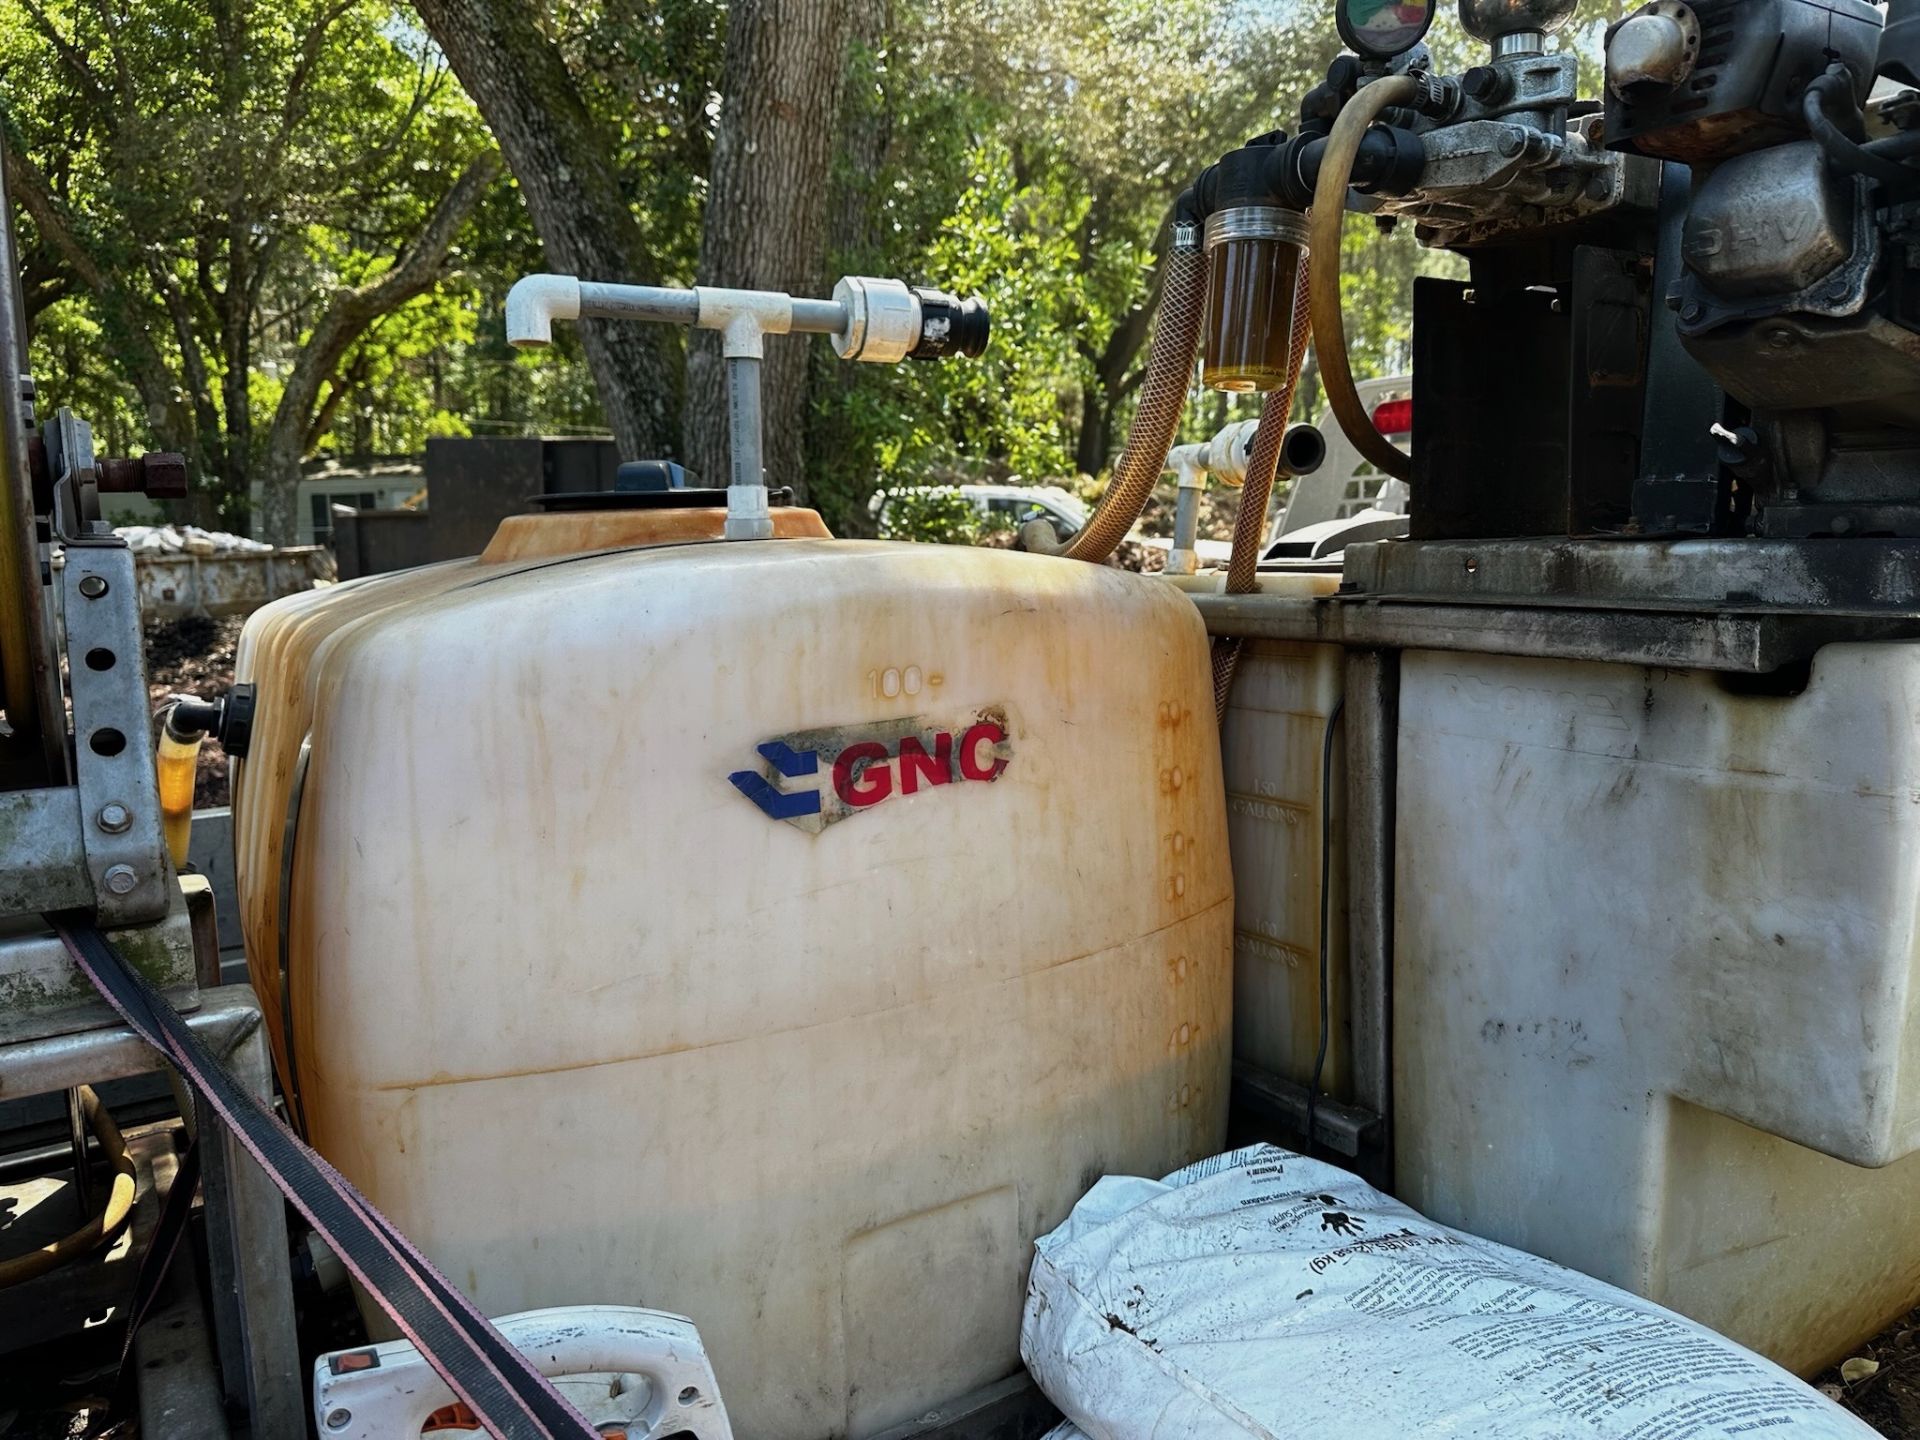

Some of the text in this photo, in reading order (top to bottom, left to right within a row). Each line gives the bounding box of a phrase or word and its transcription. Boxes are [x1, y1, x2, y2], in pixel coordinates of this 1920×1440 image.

[867, 665, 923, 699] 100
[832, 722, 1009, 807] GNC
[1233, 800, 1299, 826] GALLONS
[1235, 934, 1299, 968] GALLONS
[1246, 1164, 1284, 1178] Possum's
[1267, 1210, 1293, 1227] Supply
[1308, 1253, 1337, 1276] kg)
[1421, 1269, 1438, 1282] LLC
[1386, 1285, 1400, 1297] the
[1480, 1300, 1491, 1311] by
